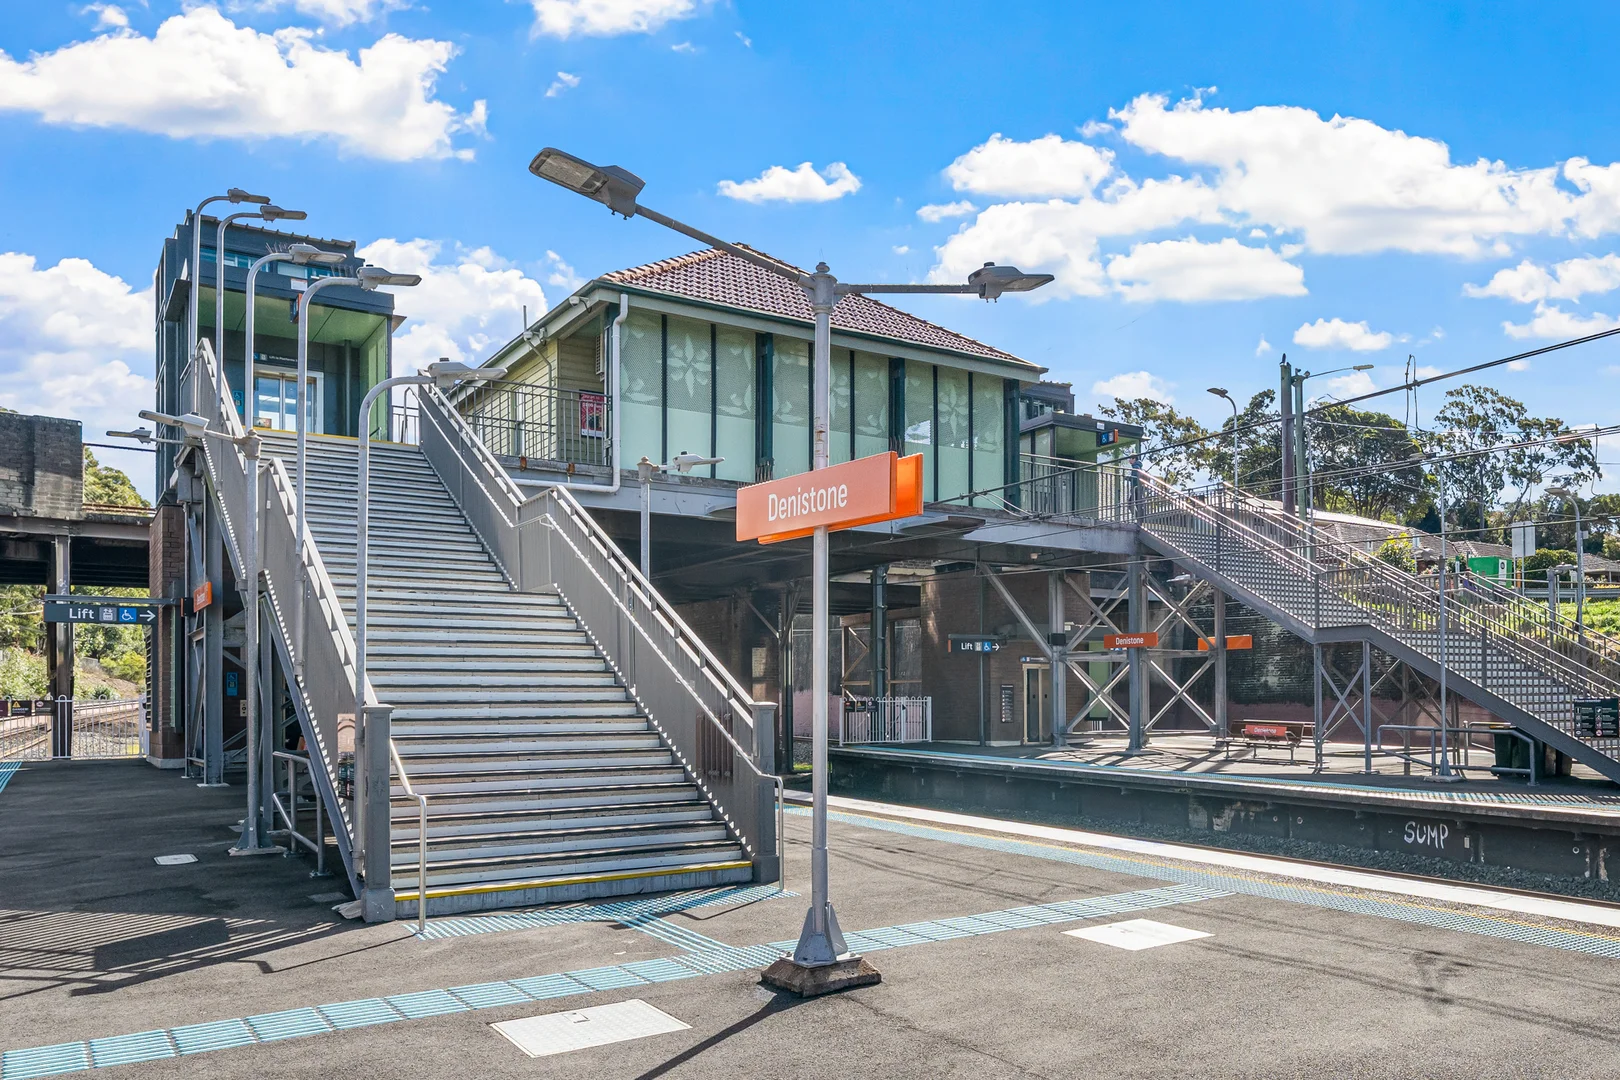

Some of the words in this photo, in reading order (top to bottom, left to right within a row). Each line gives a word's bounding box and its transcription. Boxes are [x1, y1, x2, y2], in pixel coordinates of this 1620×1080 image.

[768, 484, 848, 522] Denistone
[69, 608, 95, 619] Lift
[961, 642, 973, 650] Lift
[1115, 637, 1144, 645] Denistone
[1404, 820, 1449, 849] SUMP
